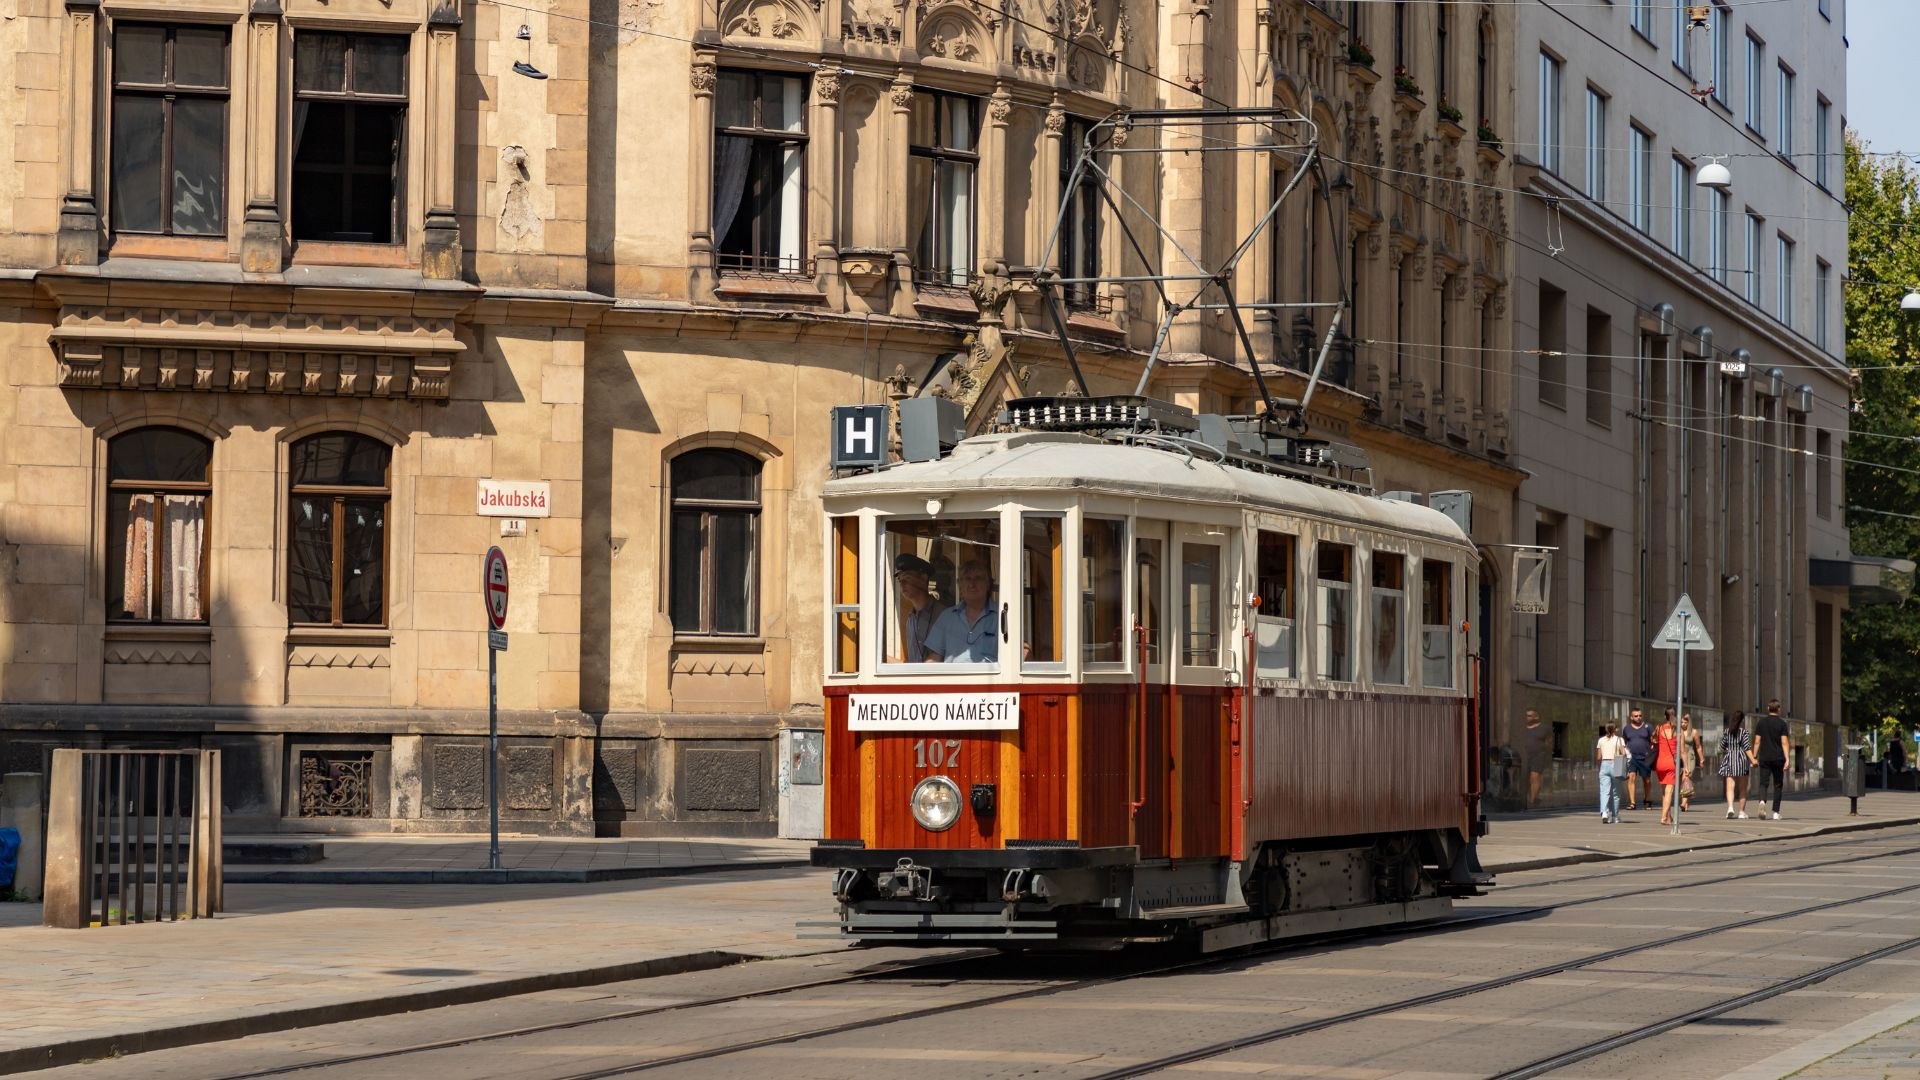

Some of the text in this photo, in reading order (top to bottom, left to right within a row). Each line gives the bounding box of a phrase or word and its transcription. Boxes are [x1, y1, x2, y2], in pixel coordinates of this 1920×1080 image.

[846, 417, 873, 453] H
[481, 489, 545, 507] Jakubská
[510, 520, 518, 529] 11
[857, 697, 1010, 721] MENDLOVO NÁMĚSTÍ
[913, 738, 962, 768] 107
